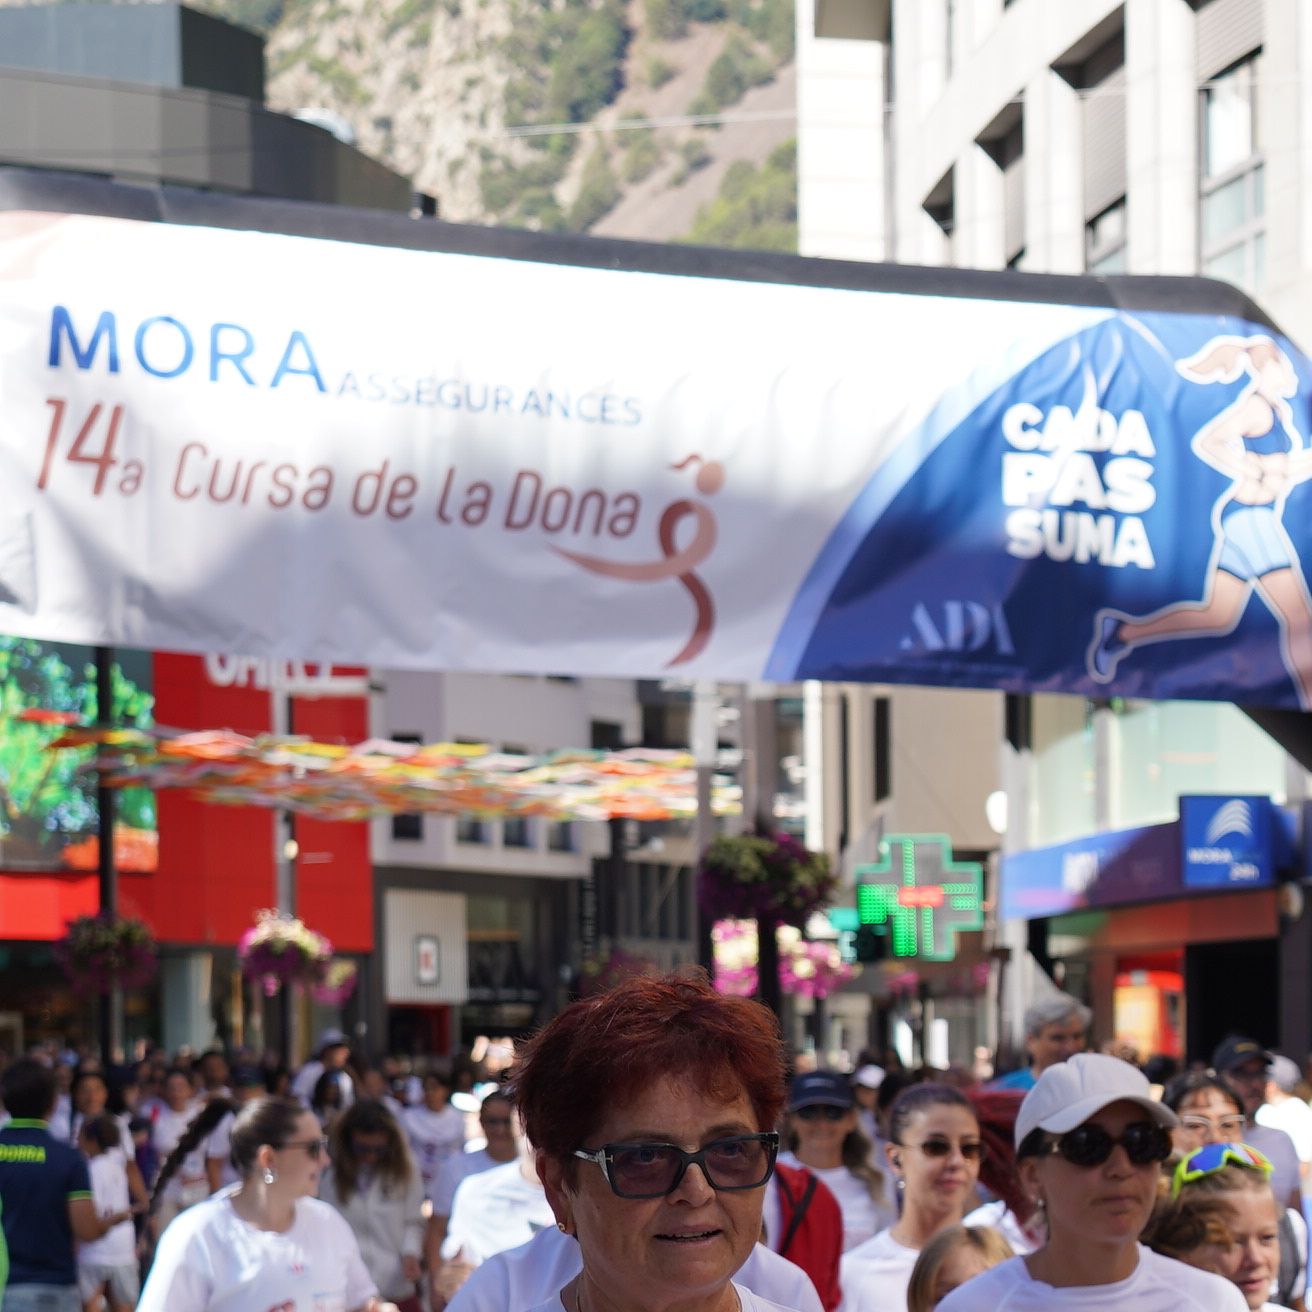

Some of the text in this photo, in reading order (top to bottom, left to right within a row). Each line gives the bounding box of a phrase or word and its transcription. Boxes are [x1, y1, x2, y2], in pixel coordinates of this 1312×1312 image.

[47, 304, 643, 427] MORA ASSEGURANCES
[1002, 401, 1156, 458] CADA
[173, 441, 333, 513] Cursa
[350, 458, 419, 519] de
[436, 478, 493, 528] la
[504, 469, 642, 541] Dona
[1002, 453, 1156, 514] PAS
[1006, 510, 1156, 570] SUMA
